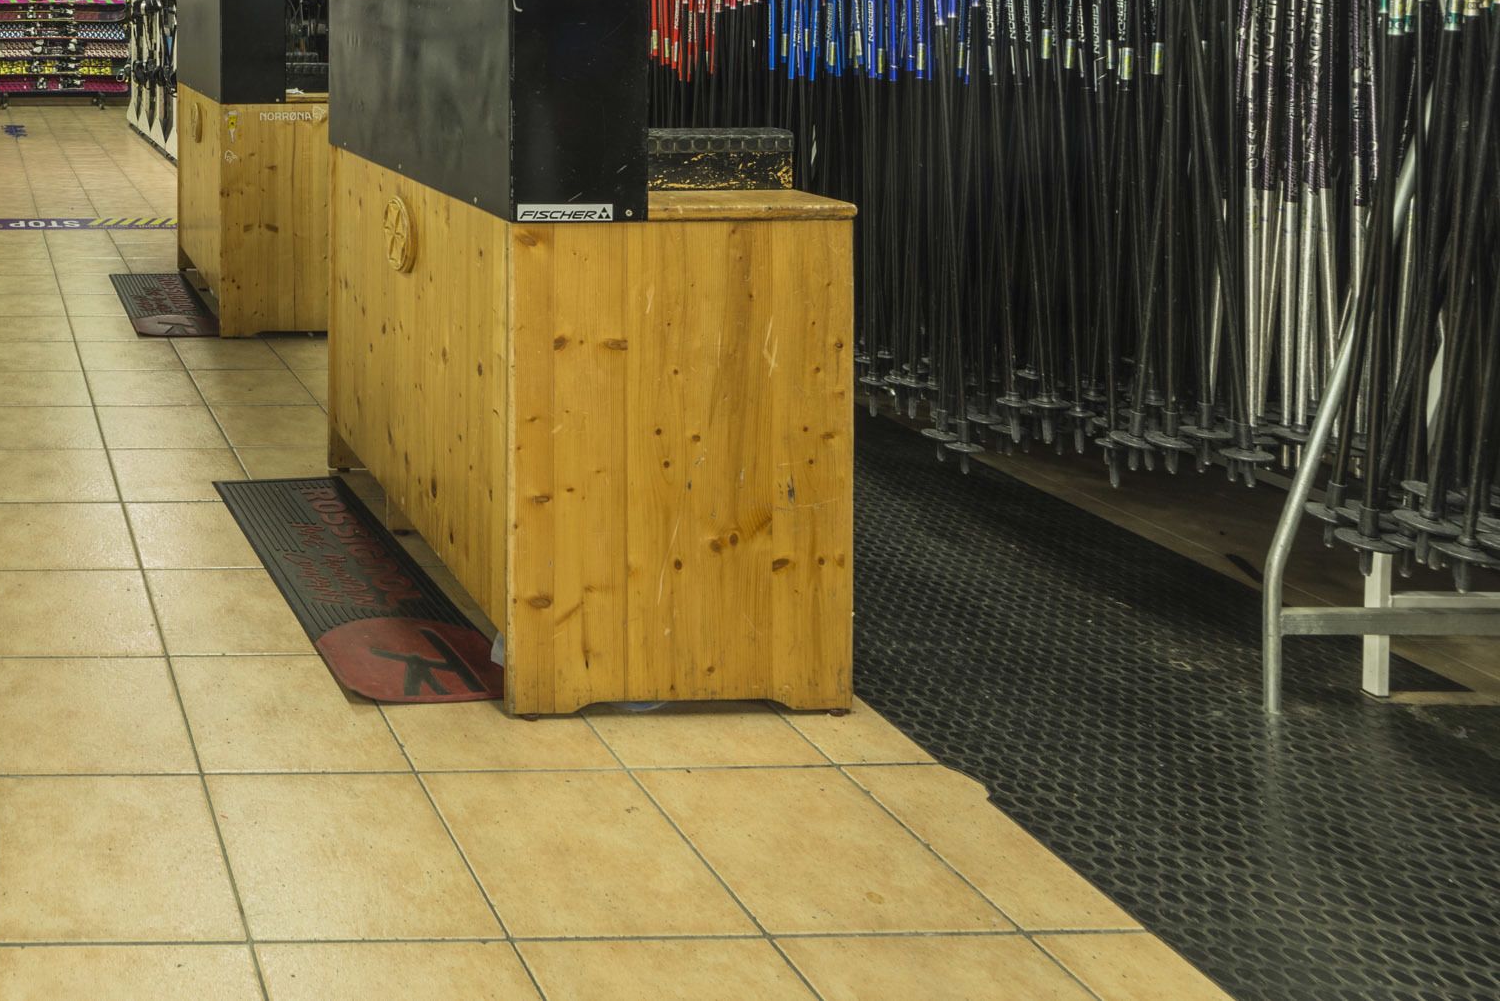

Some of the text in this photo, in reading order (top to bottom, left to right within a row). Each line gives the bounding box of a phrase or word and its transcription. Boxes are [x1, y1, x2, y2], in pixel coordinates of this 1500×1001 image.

[259, 111, 313, 122] NORRØNA
[519, 210, 599, 220] FISCHER
[9, 220, 81, 228] STOP
